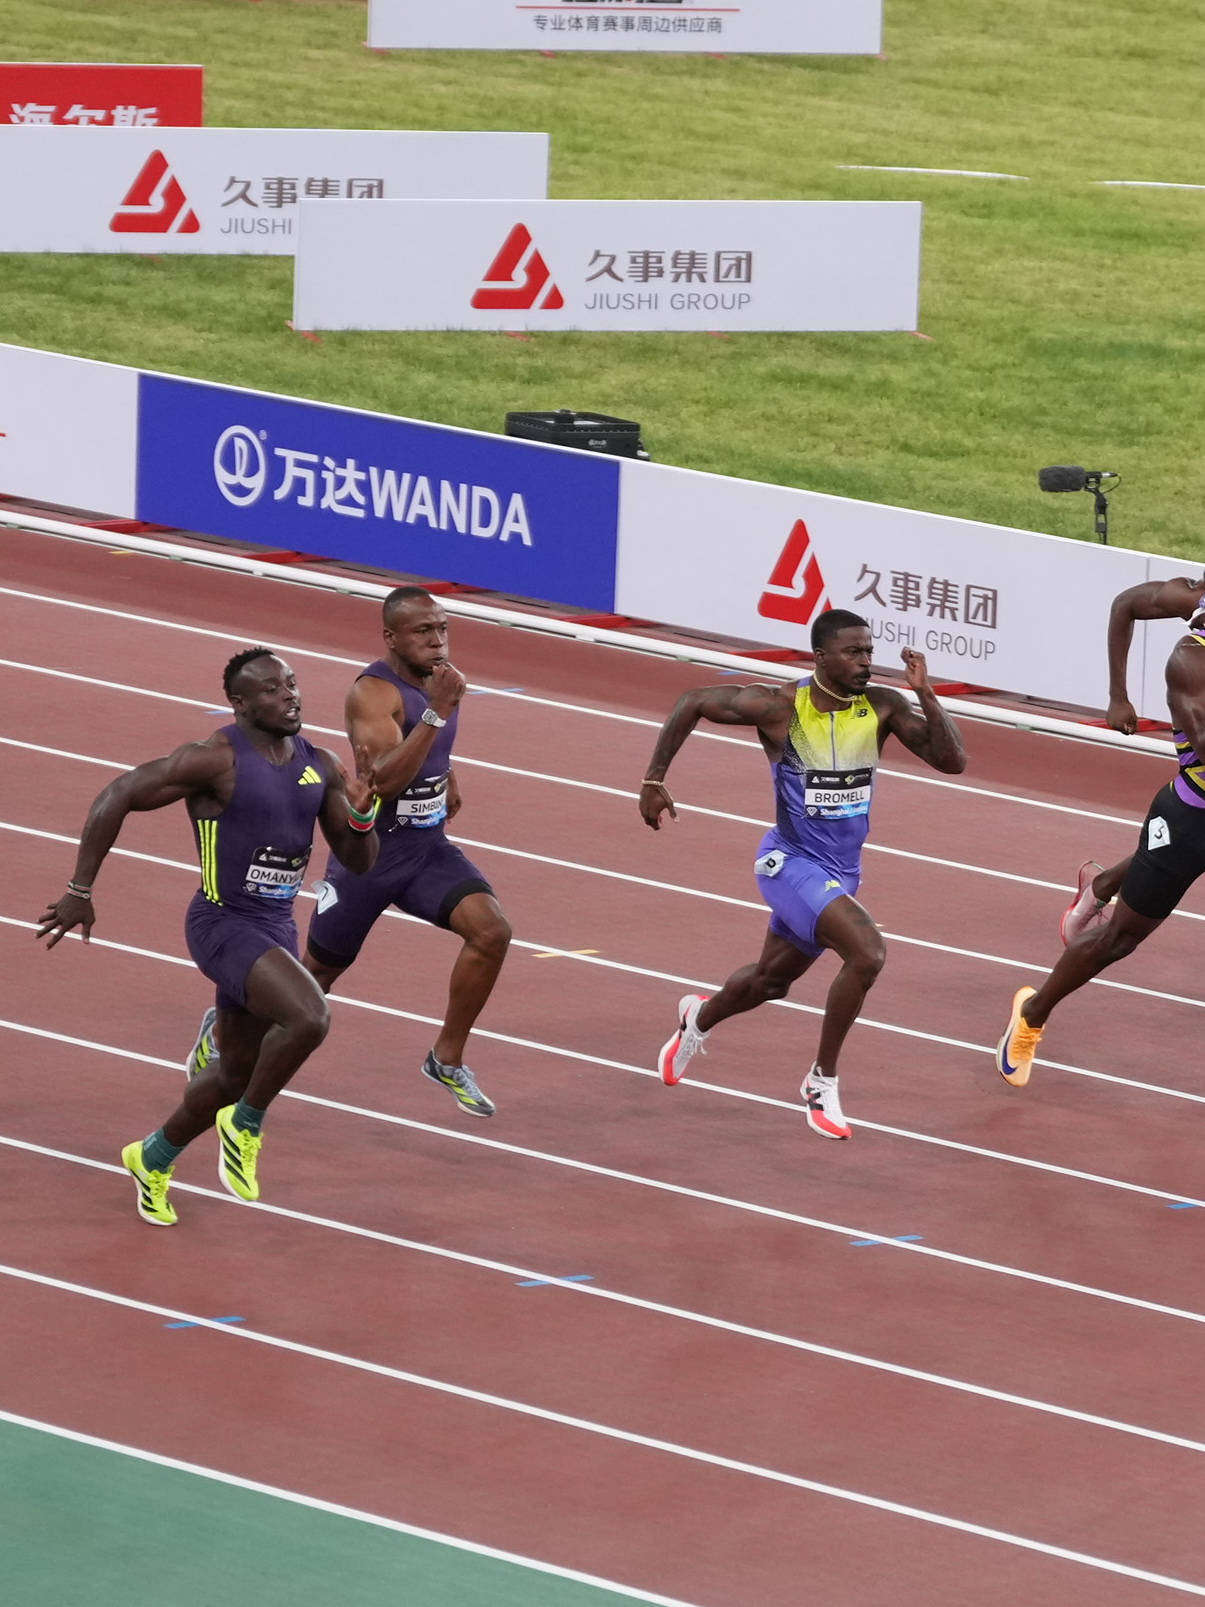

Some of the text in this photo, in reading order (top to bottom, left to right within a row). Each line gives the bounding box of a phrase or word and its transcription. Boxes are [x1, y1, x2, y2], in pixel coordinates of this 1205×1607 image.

[533, 15, 723, 33] 专业体育赛事周边供应商
[221, 217, 292, 235] JIUSHI
[585, 249, 753, 283] 久事集团
[585, 292, 752, 311] JIUSHI GROUP
[273, 447, 533, 547] 万达 WANDA
[854, 563, 998, 630] 久事集团
[925, 630, 996, 661] GROUP
[814, 790, 865, 803] BROMELL
